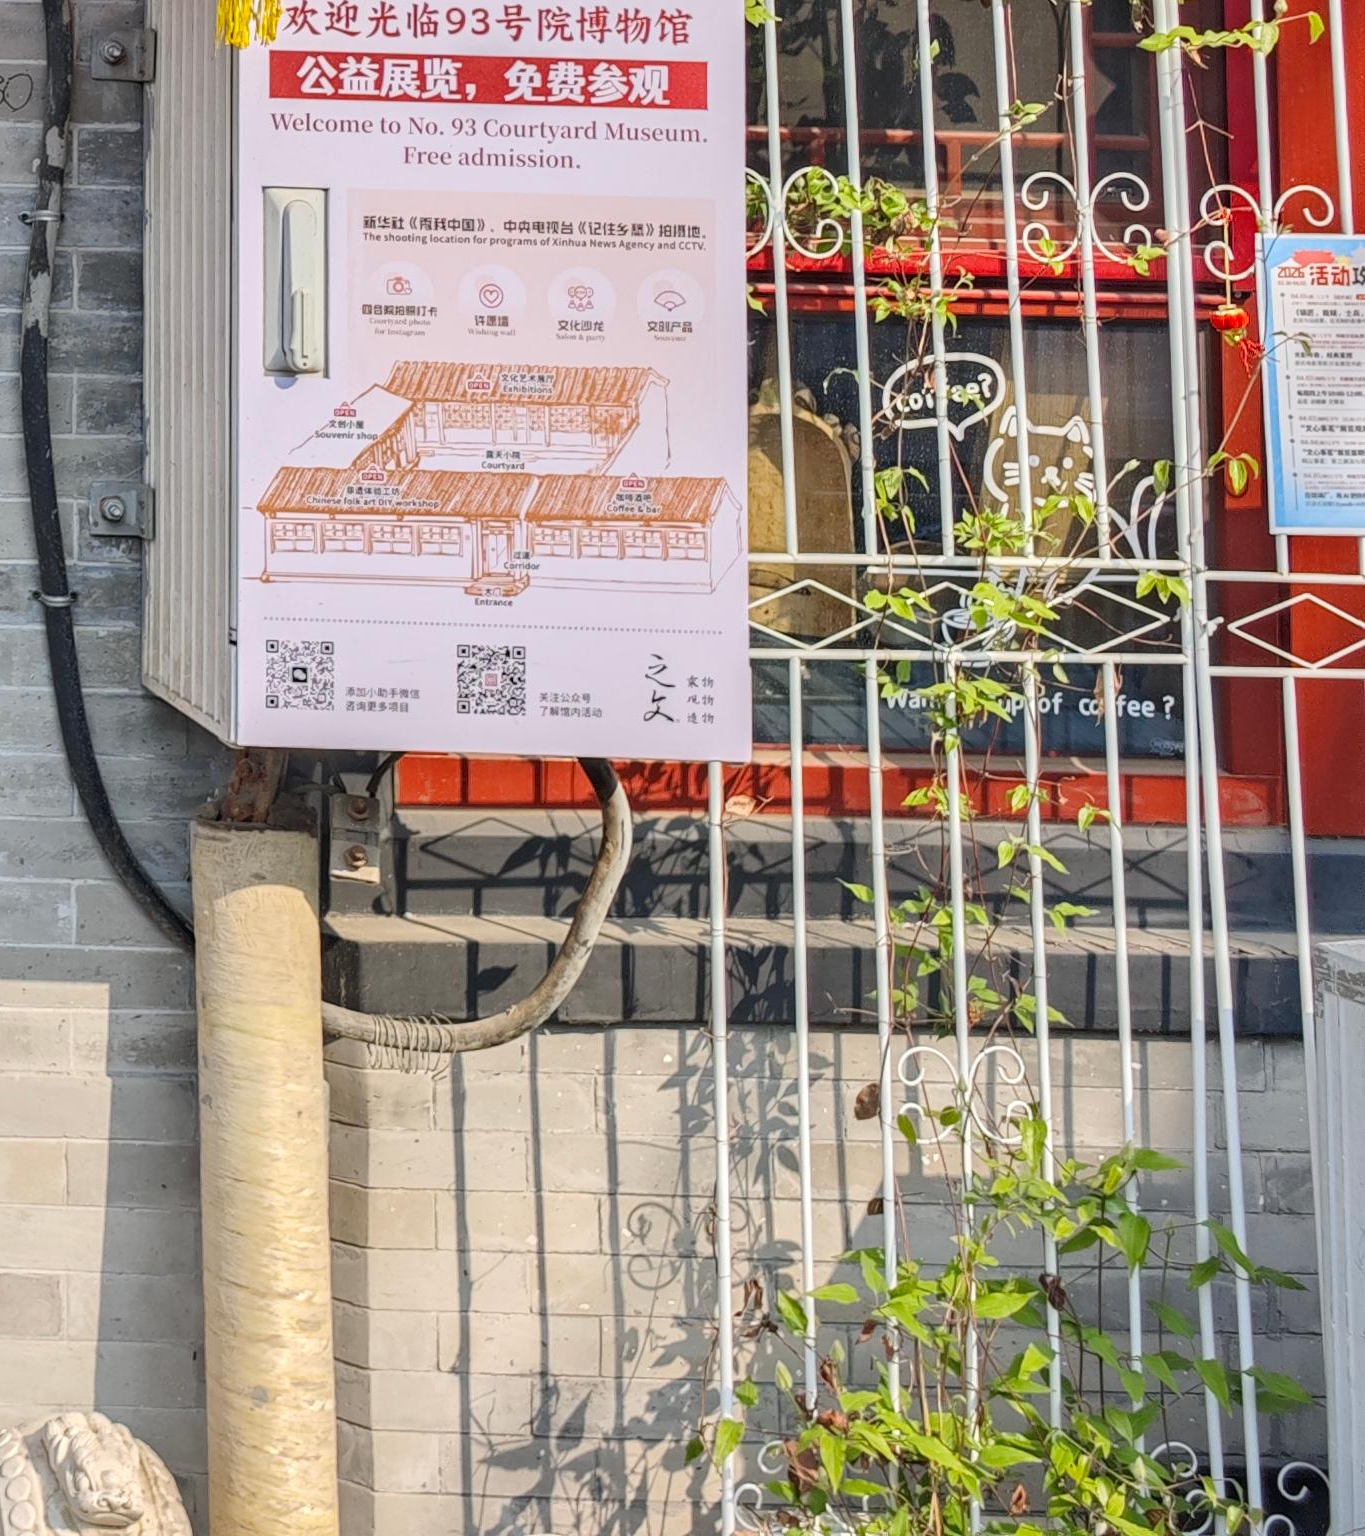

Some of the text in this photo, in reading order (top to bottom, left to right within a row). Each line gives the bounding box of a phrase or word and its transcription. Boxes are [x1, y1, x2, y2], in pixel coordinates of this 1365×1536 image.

[283, 0, 694, 46] 欢迎光临93号院博物馆
[296, 56, 671, 106] 公益展览，免费参观
[271, 112, 707, 144] Welcome to No. 93 Courtyard Museum.
[403, 146, 581, 170] Free admission.
[363, 232, 707, 251] The shooting location for programs of Xinhua News Agency and CCTV.
[1277, 267, 1304, 278] 2026
[408, 318, 431, 327] photo
[558, 319, 605, 332] 文化沙龙
[647, 321, 693, 333] 文创产品
[387, 329, 425, 337] Instagram
[556, 333, 576, 341] Salon
[586, 334, 605, 342] party
[503, 385, 553, 394] Exhibitions
[315, 430, 378, 440] Souvenir shop
[481, 461, 525, 470] Courtyard
[307, 496, 341, 504] Chinese
[344, 497, 360, 505] folk
[396, 500, 439, 508] workshop
[504, 562, 540, 570] Corridor
[475, 599, 513, 608] Entrance
[345, 686, 420, 699] 添加小助手微信
[539, 693, 591, 704] 关注公众号
[345, 701, 409, 713] 咨询更多项目
[1038, 691, 1063, 715] of
[1079, 694, 1155, 717] cofee
[539, 706, 602, 718] 了解馆内活动
